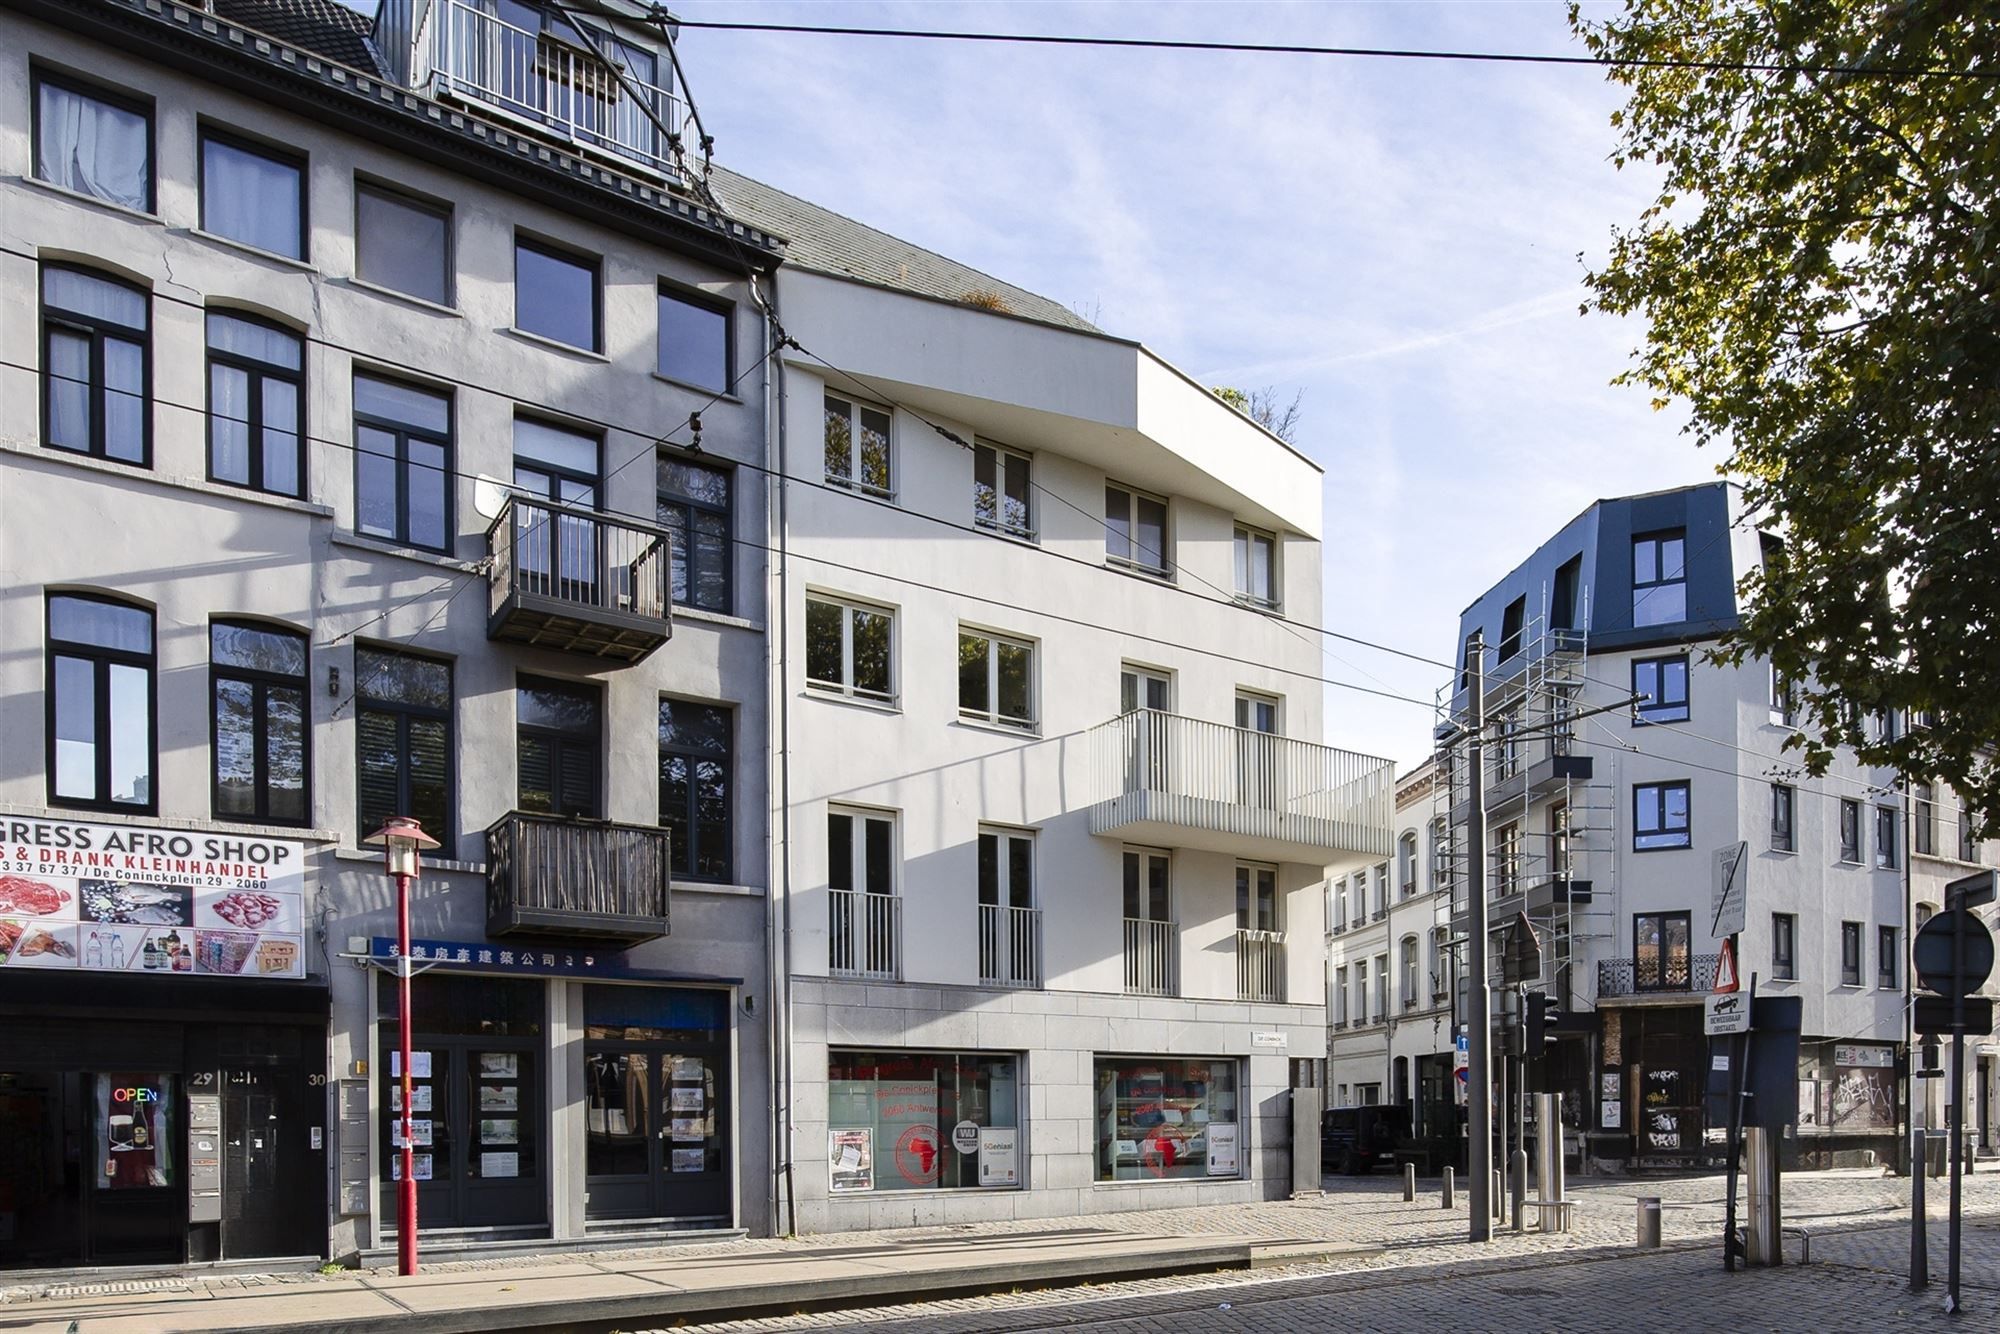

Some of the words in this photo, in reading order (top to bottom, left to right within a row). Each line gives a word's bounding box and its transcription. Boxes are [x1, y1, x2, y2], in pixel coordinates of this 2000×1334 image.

[0, 821, 91, 849] RESS
[103, 831, 192, 858] AFRO
[205, 839, 290, 865] SHOP
[16, 846, 28, 861] &
[40, 848, 114, 867] DRANK
[125, 852, 269, 879] KLEINHANDEL
[16, 862, 33, 873] 37
[39, 864, 55, 874] 67
[61, 865, 78, 876] 37
[94, 868, 110, 878] De
[116, 869, 203, 886] Coninckplein
[207, 876, 222, 887] 29
[236, 879, 267, 890] 2060
[193, 1073, 213, 1086] 29
[308, 1074, 326, 1086] 30
[114, 1088, 157, 1102] OPEN
